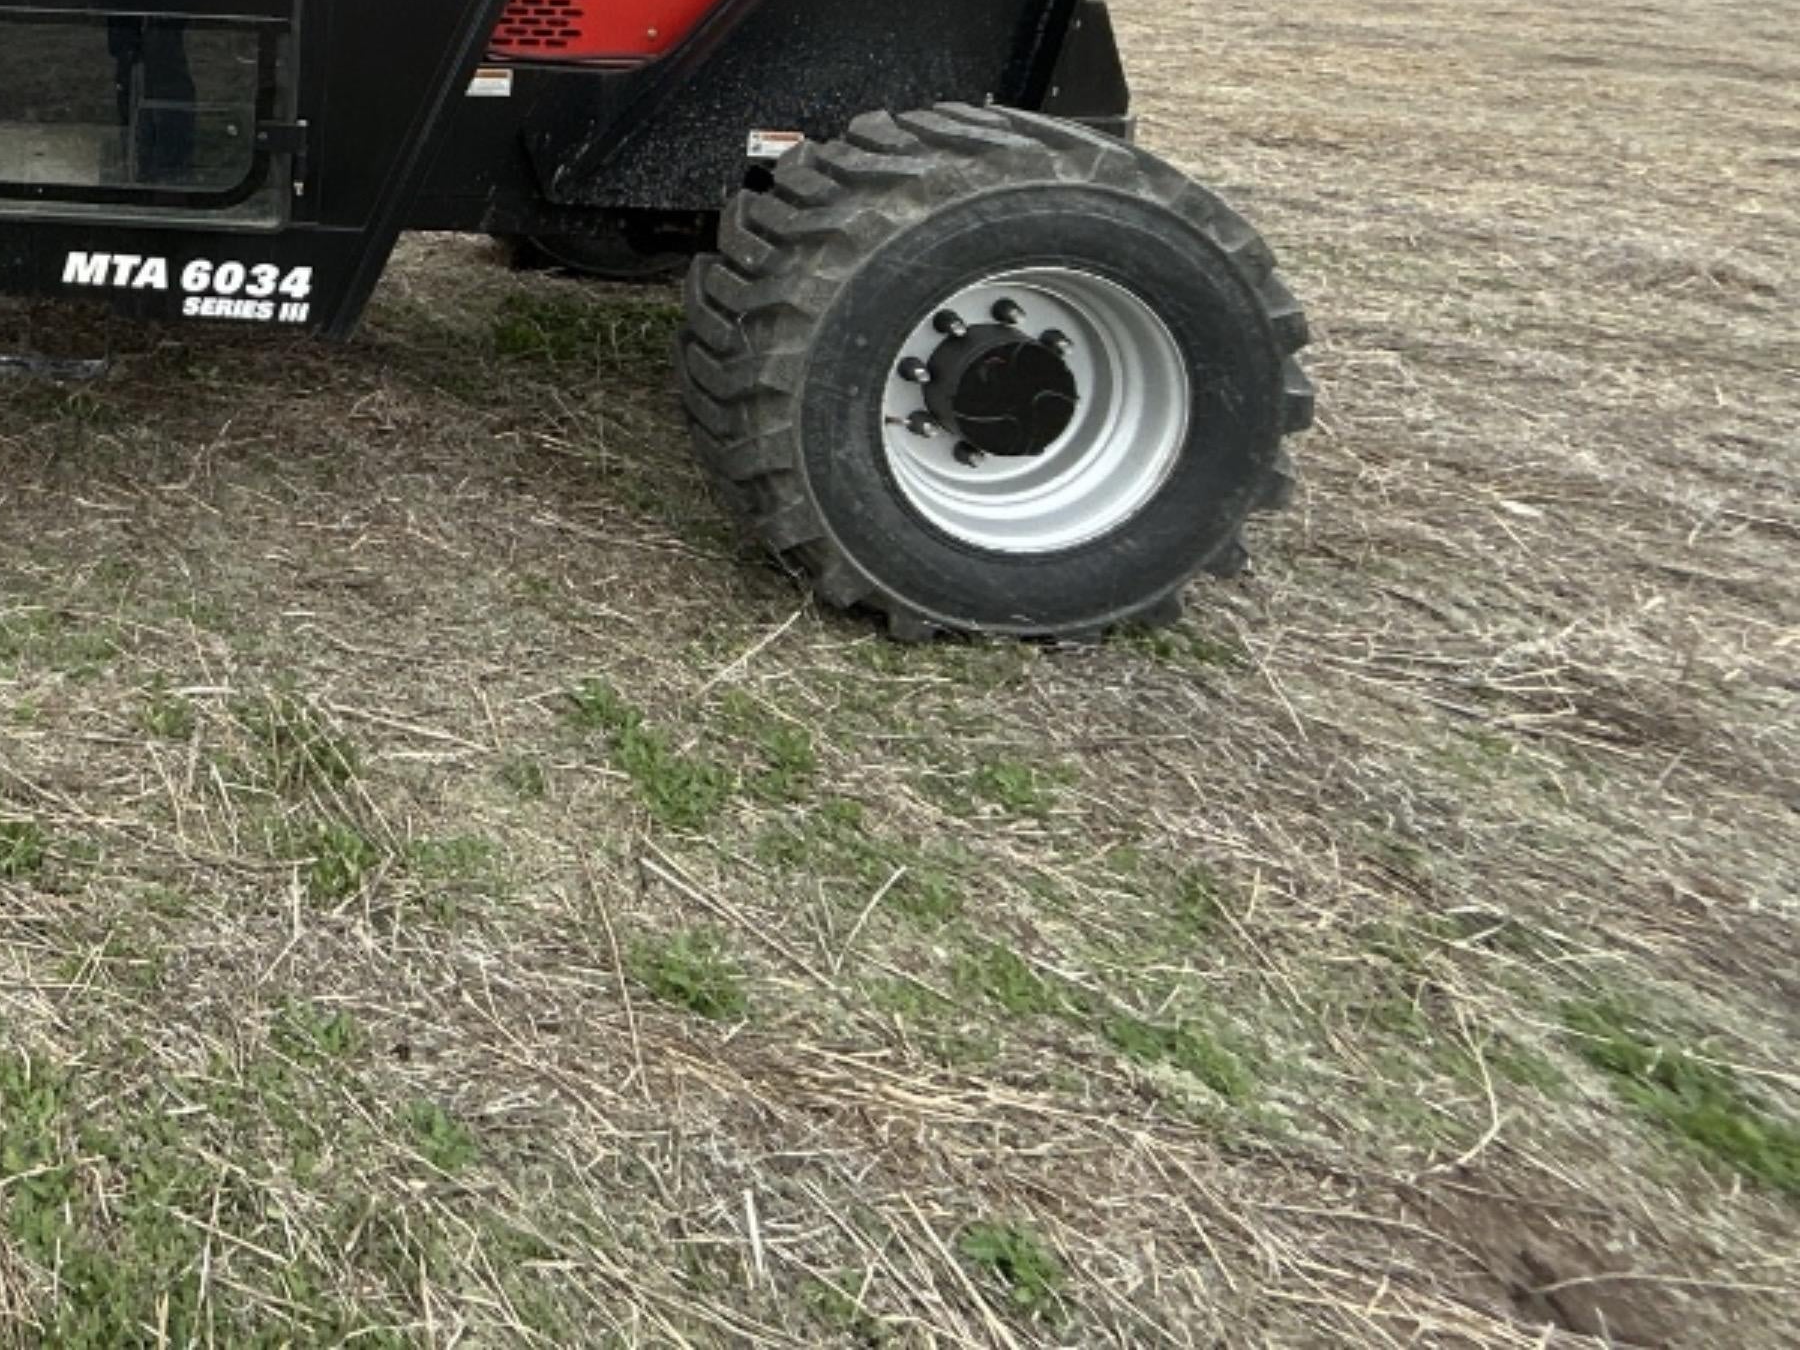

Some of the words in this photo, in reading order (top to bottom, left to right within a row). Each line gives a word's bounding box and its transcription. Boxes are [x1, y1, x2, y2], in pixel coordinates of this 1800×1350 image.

[62, 251, 168, 289] MTA
[181, 257, 312, 298] 6034
[183, 297, 274, 320] SERIES
[278, 302, 310, 322] III
